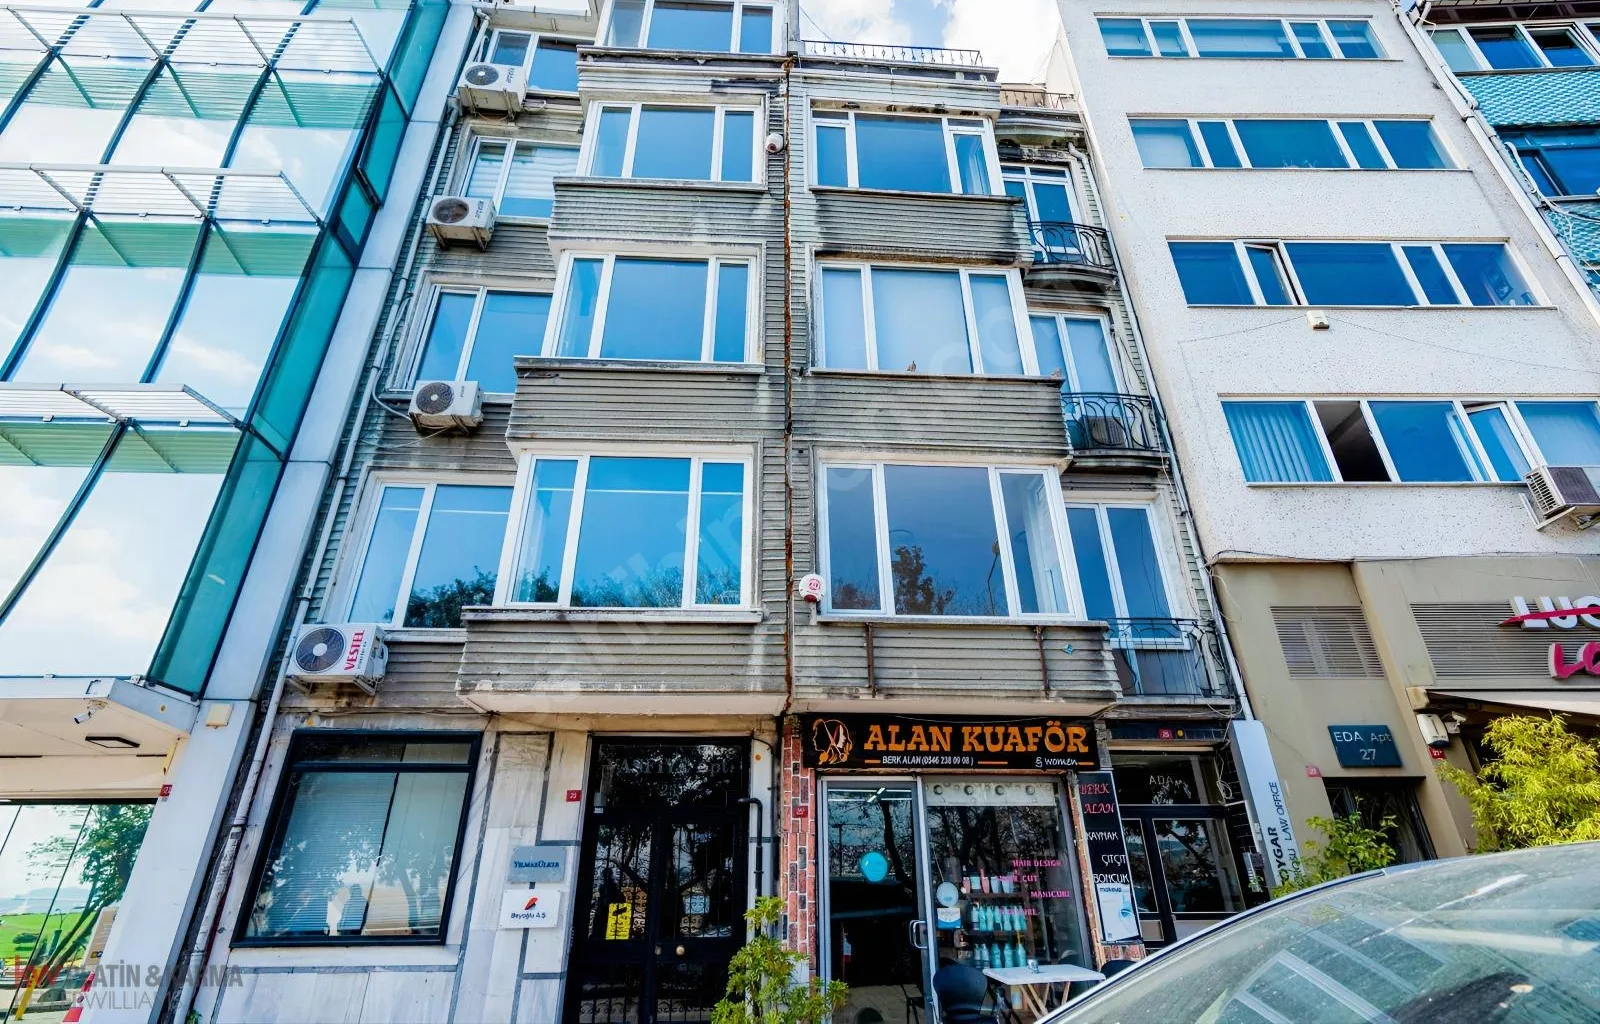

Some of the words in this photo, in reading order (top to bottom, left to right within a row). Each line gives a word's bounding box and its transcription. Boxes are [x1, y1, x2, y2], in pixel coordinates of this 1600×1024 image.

[344, 629, 365, 671] VESTEL
[864, 725, 952, 752] ALAN
[962, 720, 1089, 753] KUAFÖR
[1334, 731, 1364, 742] EDA
[1370, 733, 1392, 744] Apt
[882, 756, 901, 764] BERK
[902, 756, 920, 764] ALAN
[1360, 749, 1376, 760] 27
[1044, 757, 1079, 767] women
[1080, 783, 1110, 795] BERK
[1269, 781, 1285, 816] OFFICE
[1084, 803, 1115, 814] ALAN
[1280, 819, 1292, 841] LAW
[1093, 873, 1130, 884] BONCUK
